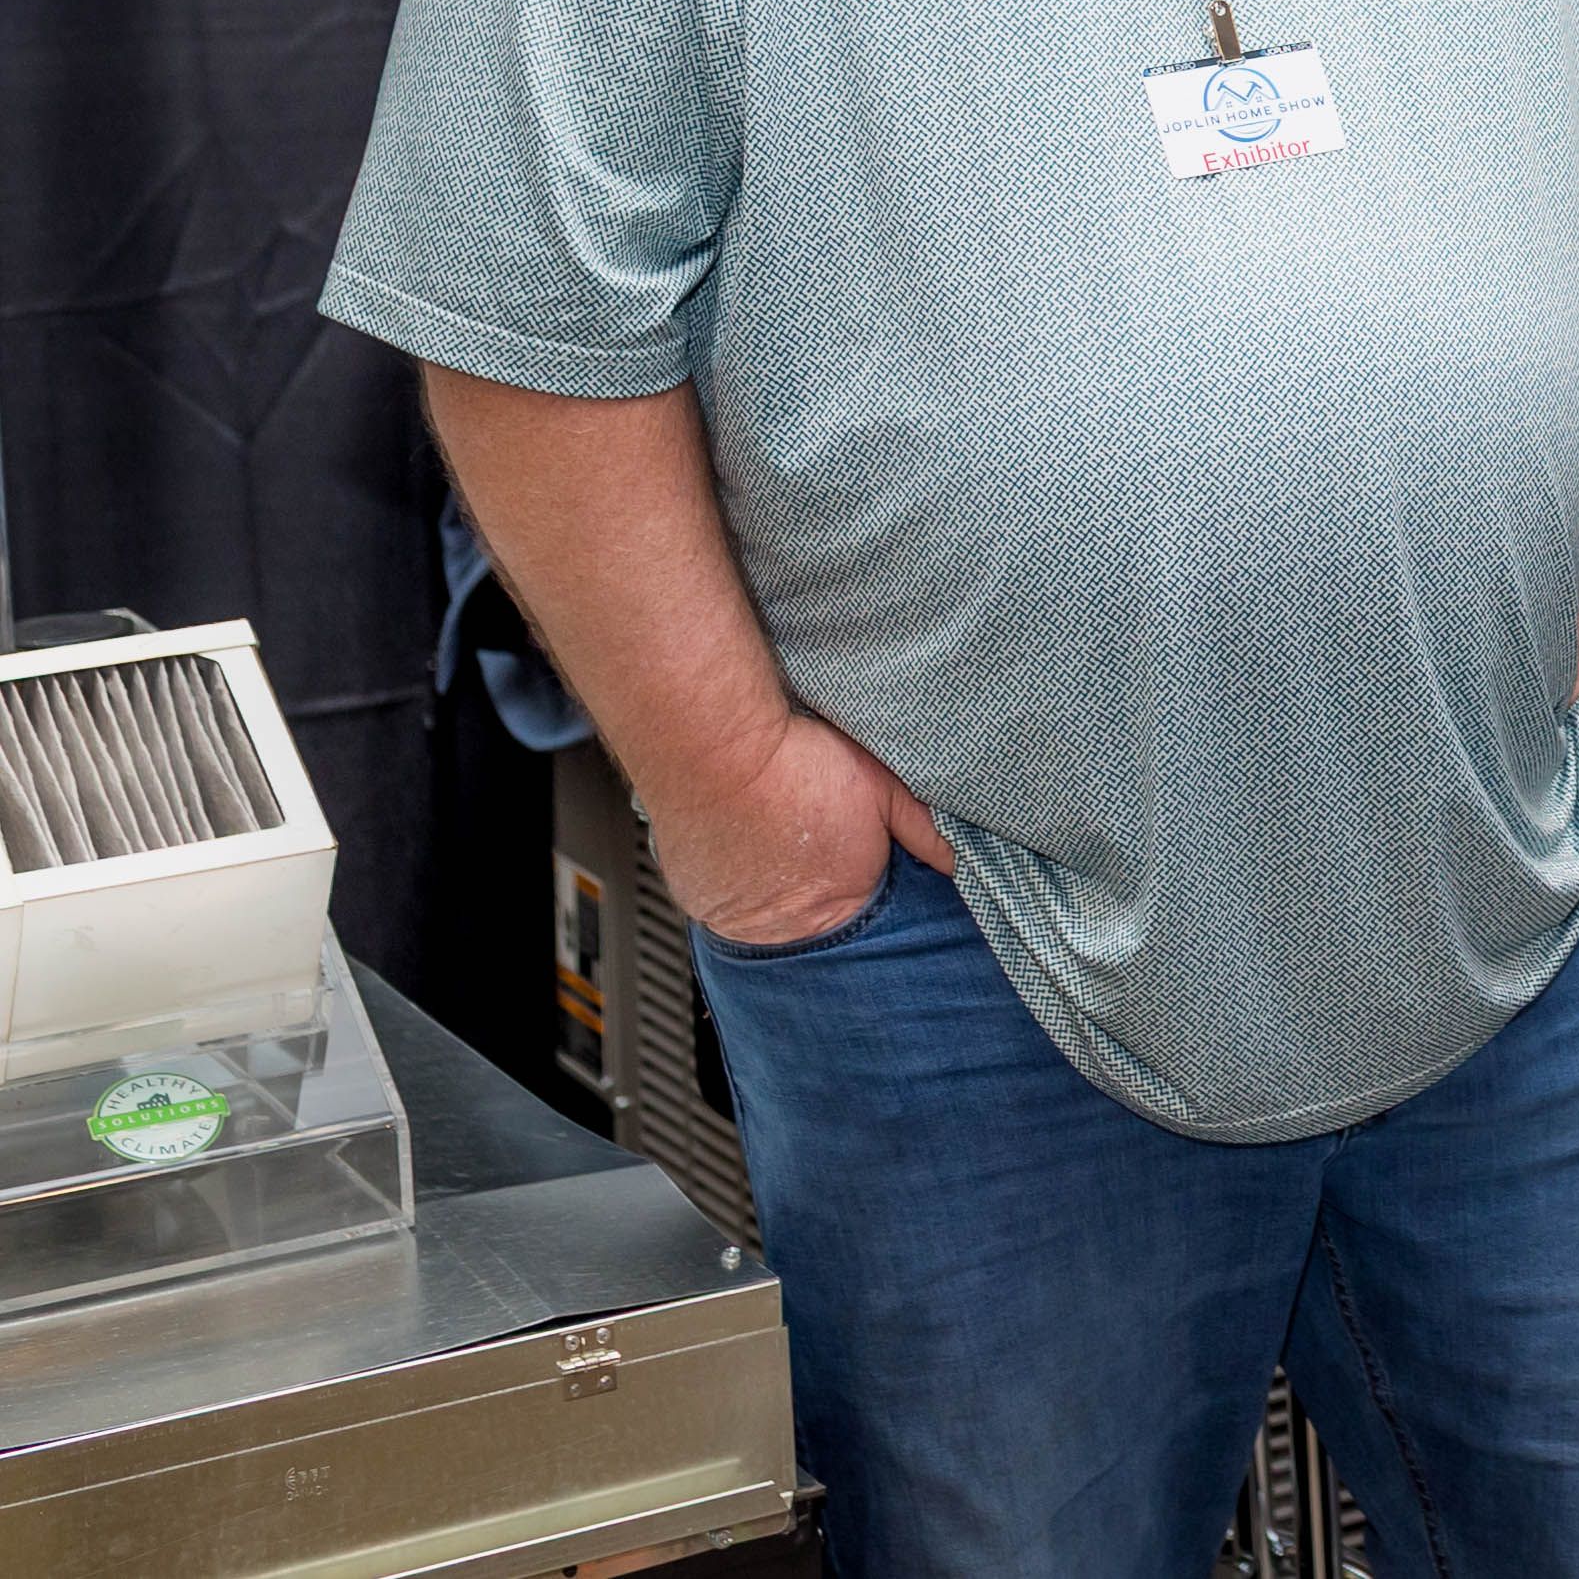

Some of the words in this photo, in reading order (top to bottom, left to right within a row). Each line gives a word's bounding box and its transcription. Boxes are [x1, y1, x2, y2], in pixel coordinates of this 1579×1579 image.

[1163, 114, 1221, 134] JOPLIN
[1226, 104, 1273, 123] HOME
[1279, 96, 1326, 113] SHOW
[1202, 138, 1311, 172] Exhibitor
[107, 1076, 202, 1111] HEALTHY
[97, 1099, 221, 1131] SOLUTIONS
[121, 1124, 213, 1156] CLIMATE
